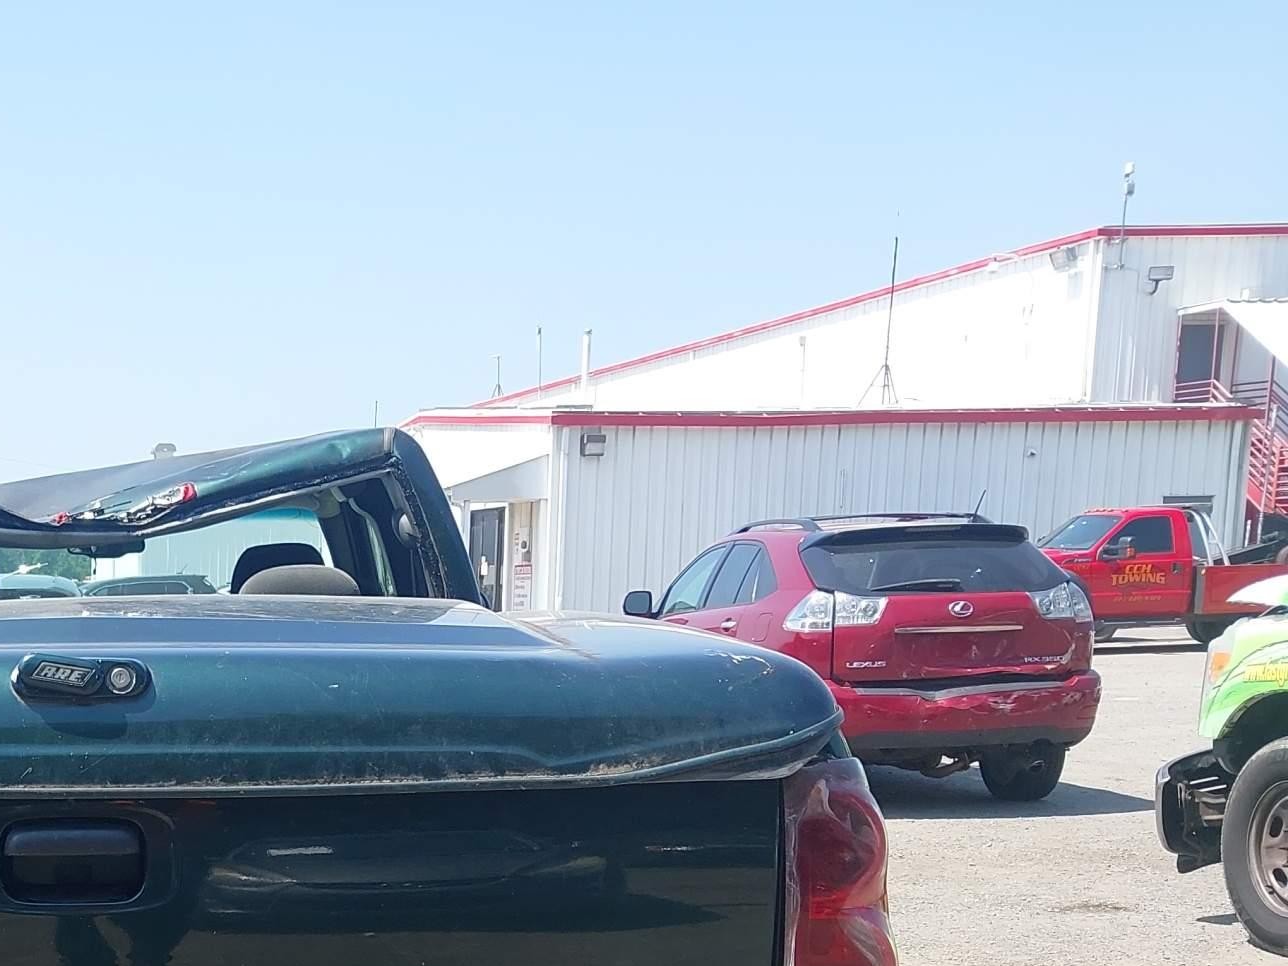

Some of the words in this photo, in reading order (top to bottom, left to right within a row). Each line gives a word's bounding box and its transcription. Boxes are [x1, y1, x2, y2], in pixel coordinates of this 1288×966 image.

[1125, 563, 1153, 574] CCH
[1111, 572, 1166, 586] TOWING
[845, 660, 887, 669] LEXUS
